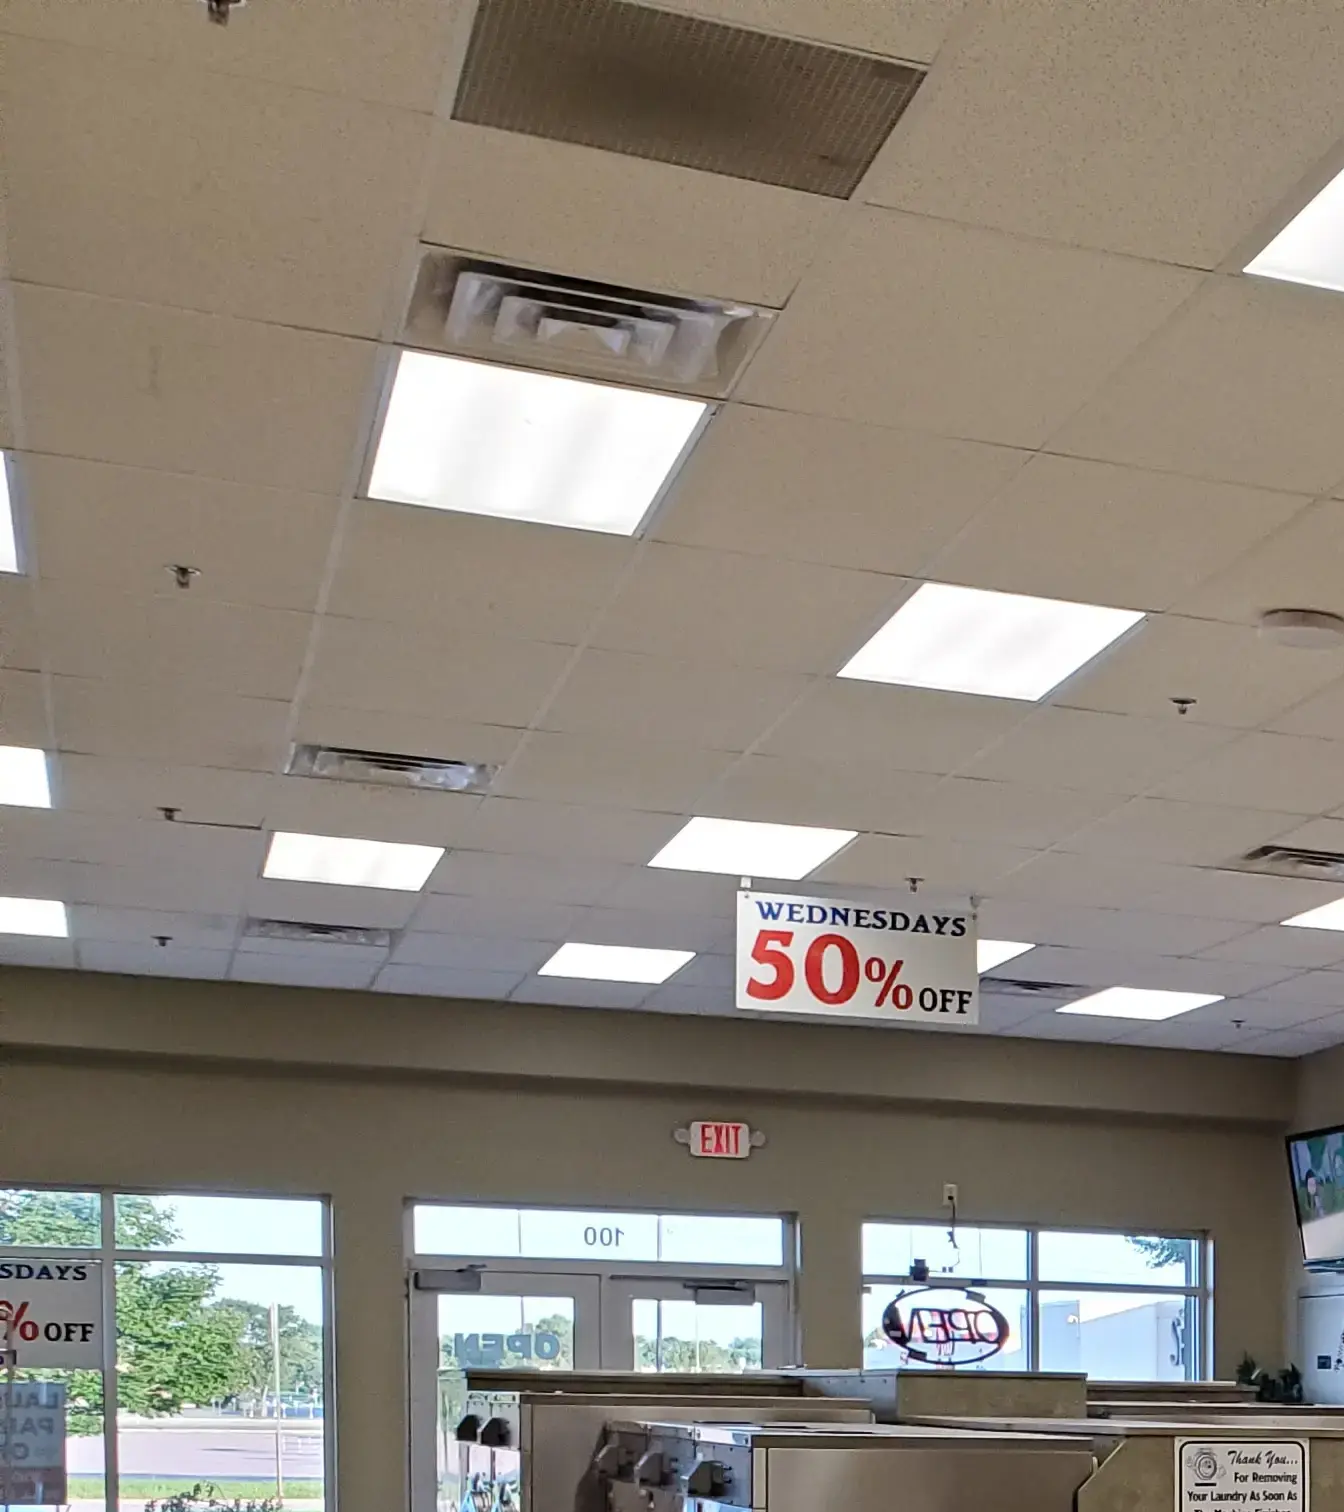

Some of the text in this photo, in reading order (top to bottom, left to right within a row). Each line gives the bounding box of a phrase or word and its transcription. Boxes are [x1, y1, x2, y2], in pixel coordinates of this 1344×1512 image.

[755, 901, 967, 937] WEDNESDAYS
[746, 929, 973, 1015] 50% OFF
[701, 1124, 741, 1156] EXIT
[44, 1322, 94, 1343] OFF
[1227, 1450, 1262, 1465] Thank
[1234, 1472, 1298, 1485] For Removing
[1187, 1490, 1298, 1504] Your Laundry As Soon As
